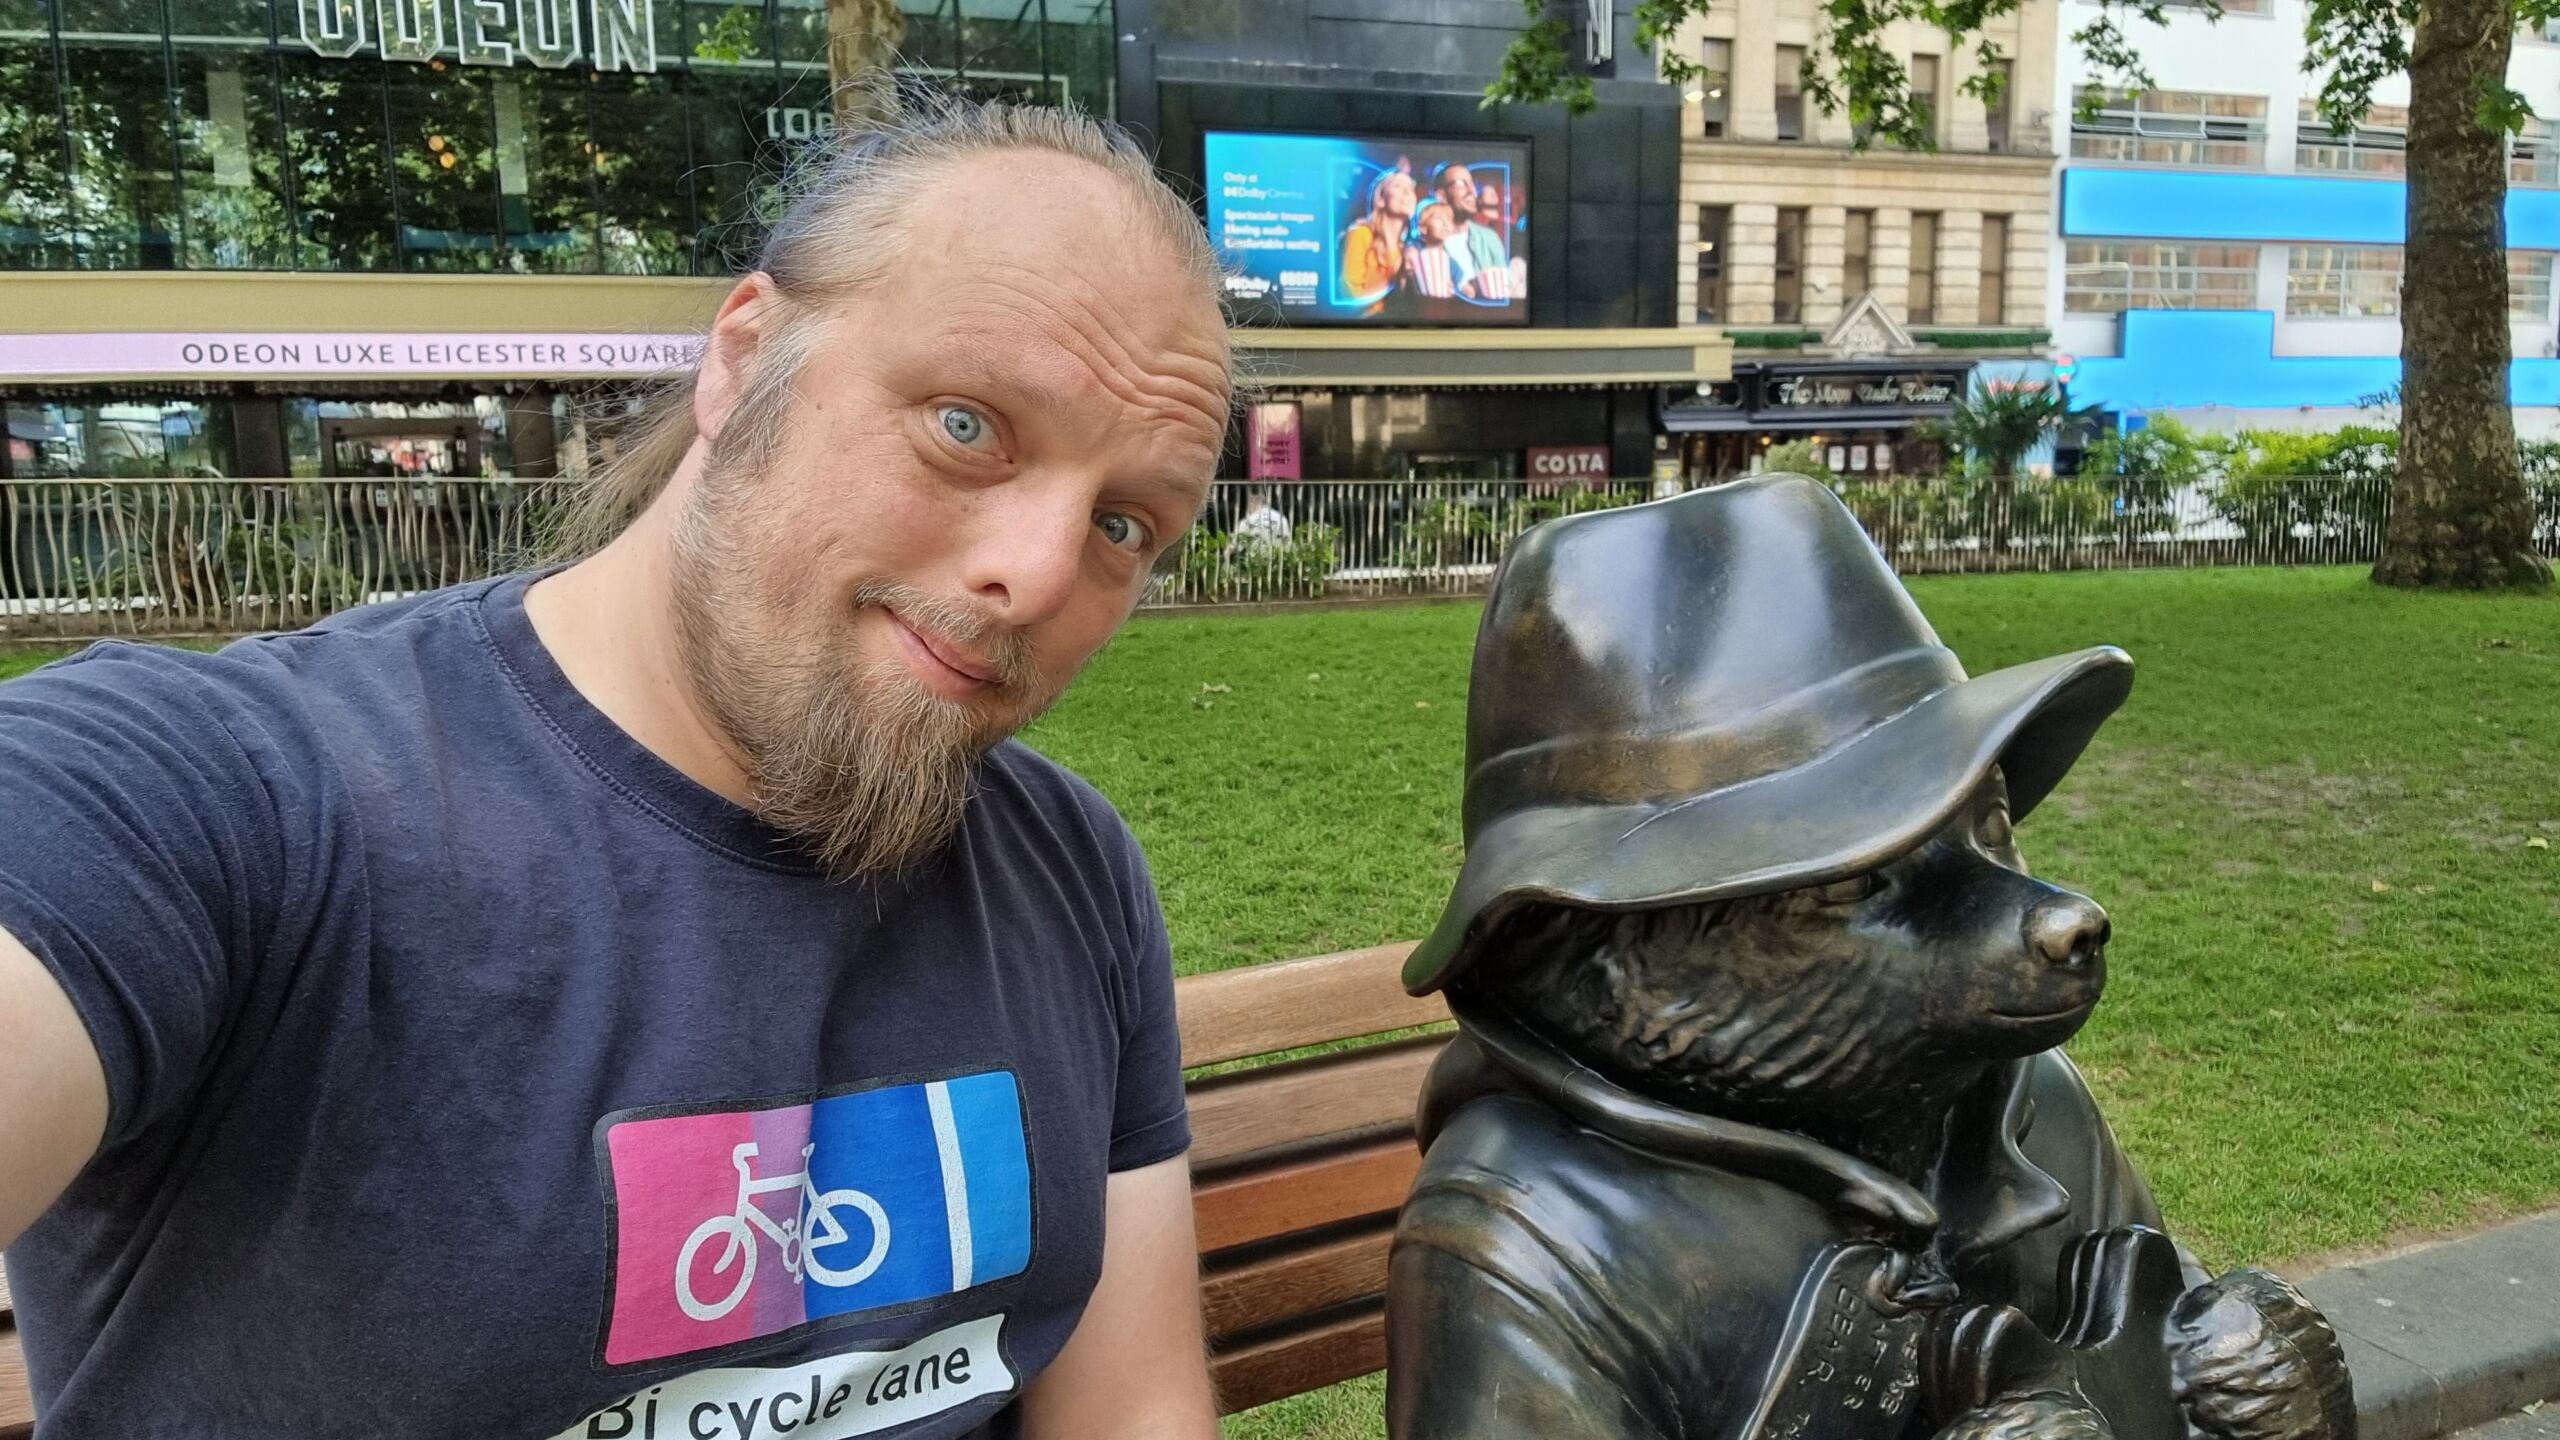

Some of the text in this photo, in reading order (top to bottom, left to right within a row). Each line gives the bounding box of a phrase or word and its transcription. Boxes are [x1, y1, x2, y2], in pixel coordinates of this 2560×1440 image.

[297, 0, 658, 73] ODEON
[182, 343, 697, 367] ODEON LUXE LEICESTER SQUARE
[1535, 453, 1605, 475] COSTA
[586, 1347, 972, 1440] Bi cycle lane
